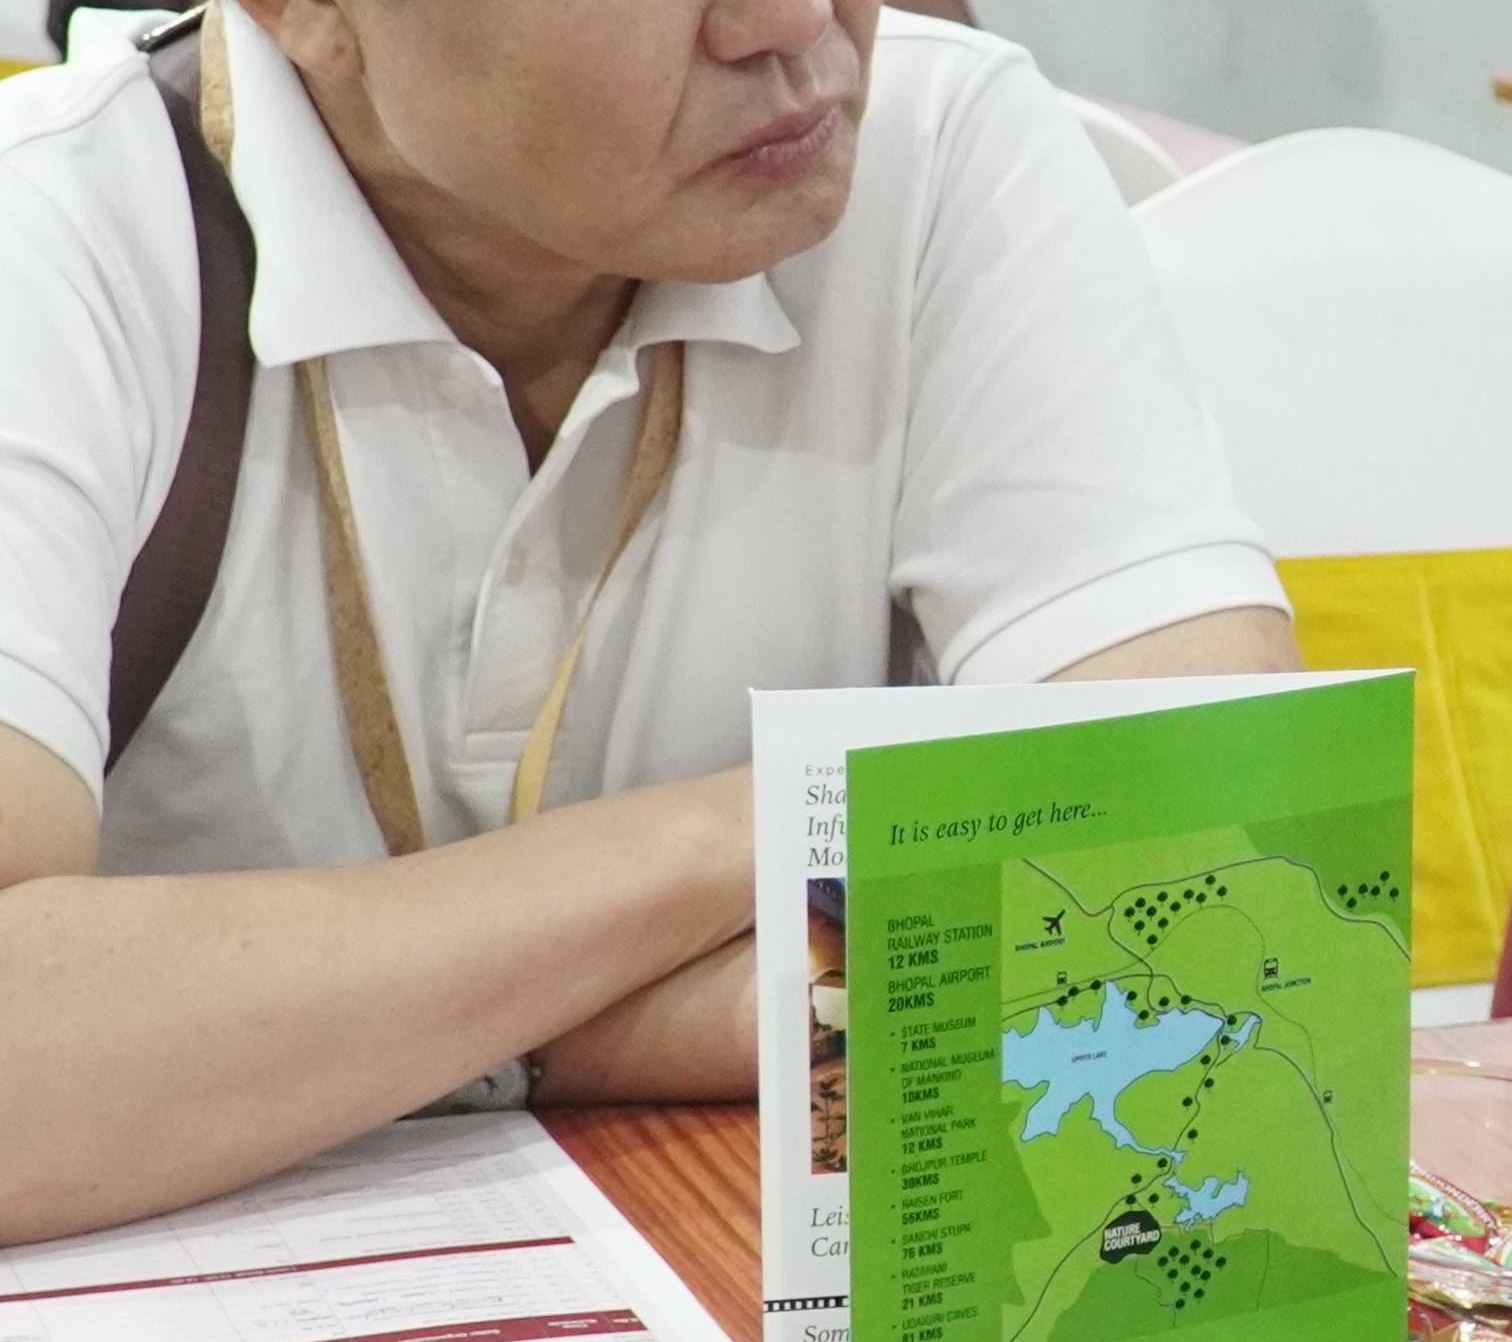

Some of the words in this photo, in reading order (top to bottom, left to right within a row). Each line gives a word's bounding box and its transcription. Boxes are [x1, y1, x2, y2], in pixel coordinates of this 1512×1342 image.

[890, 824, 904, 846] It
[912, 821, 928, 843] is
[936, 818, 981, 843] easy
[989, 813, 1007, 832] to
[1012, 808, 1042, 836] get
[1049, 802, 1107, 824] here...
[888, 915, 935, 933] BHOPAL
[888, 932, 940, 951] RAILWAY
[944, 925, 993, 944] STATION
[888, 955, 904, 970] 12
[908, 949, 939, 967] KMS
[888, 976, 935, 994] BHOPAL
[939, 965, 992, 987] AIRPORT
[911, 1037, 936, 1052] KMS
[918, 1137, 943, 1152] KMS
[1104, 1229, 1160, 1251] COURTYARD
[918, 1242, 943, 1257] KMS
[918, 1292, 944, 1307] KMS
[918, 1327, 943, 1342] KMS
